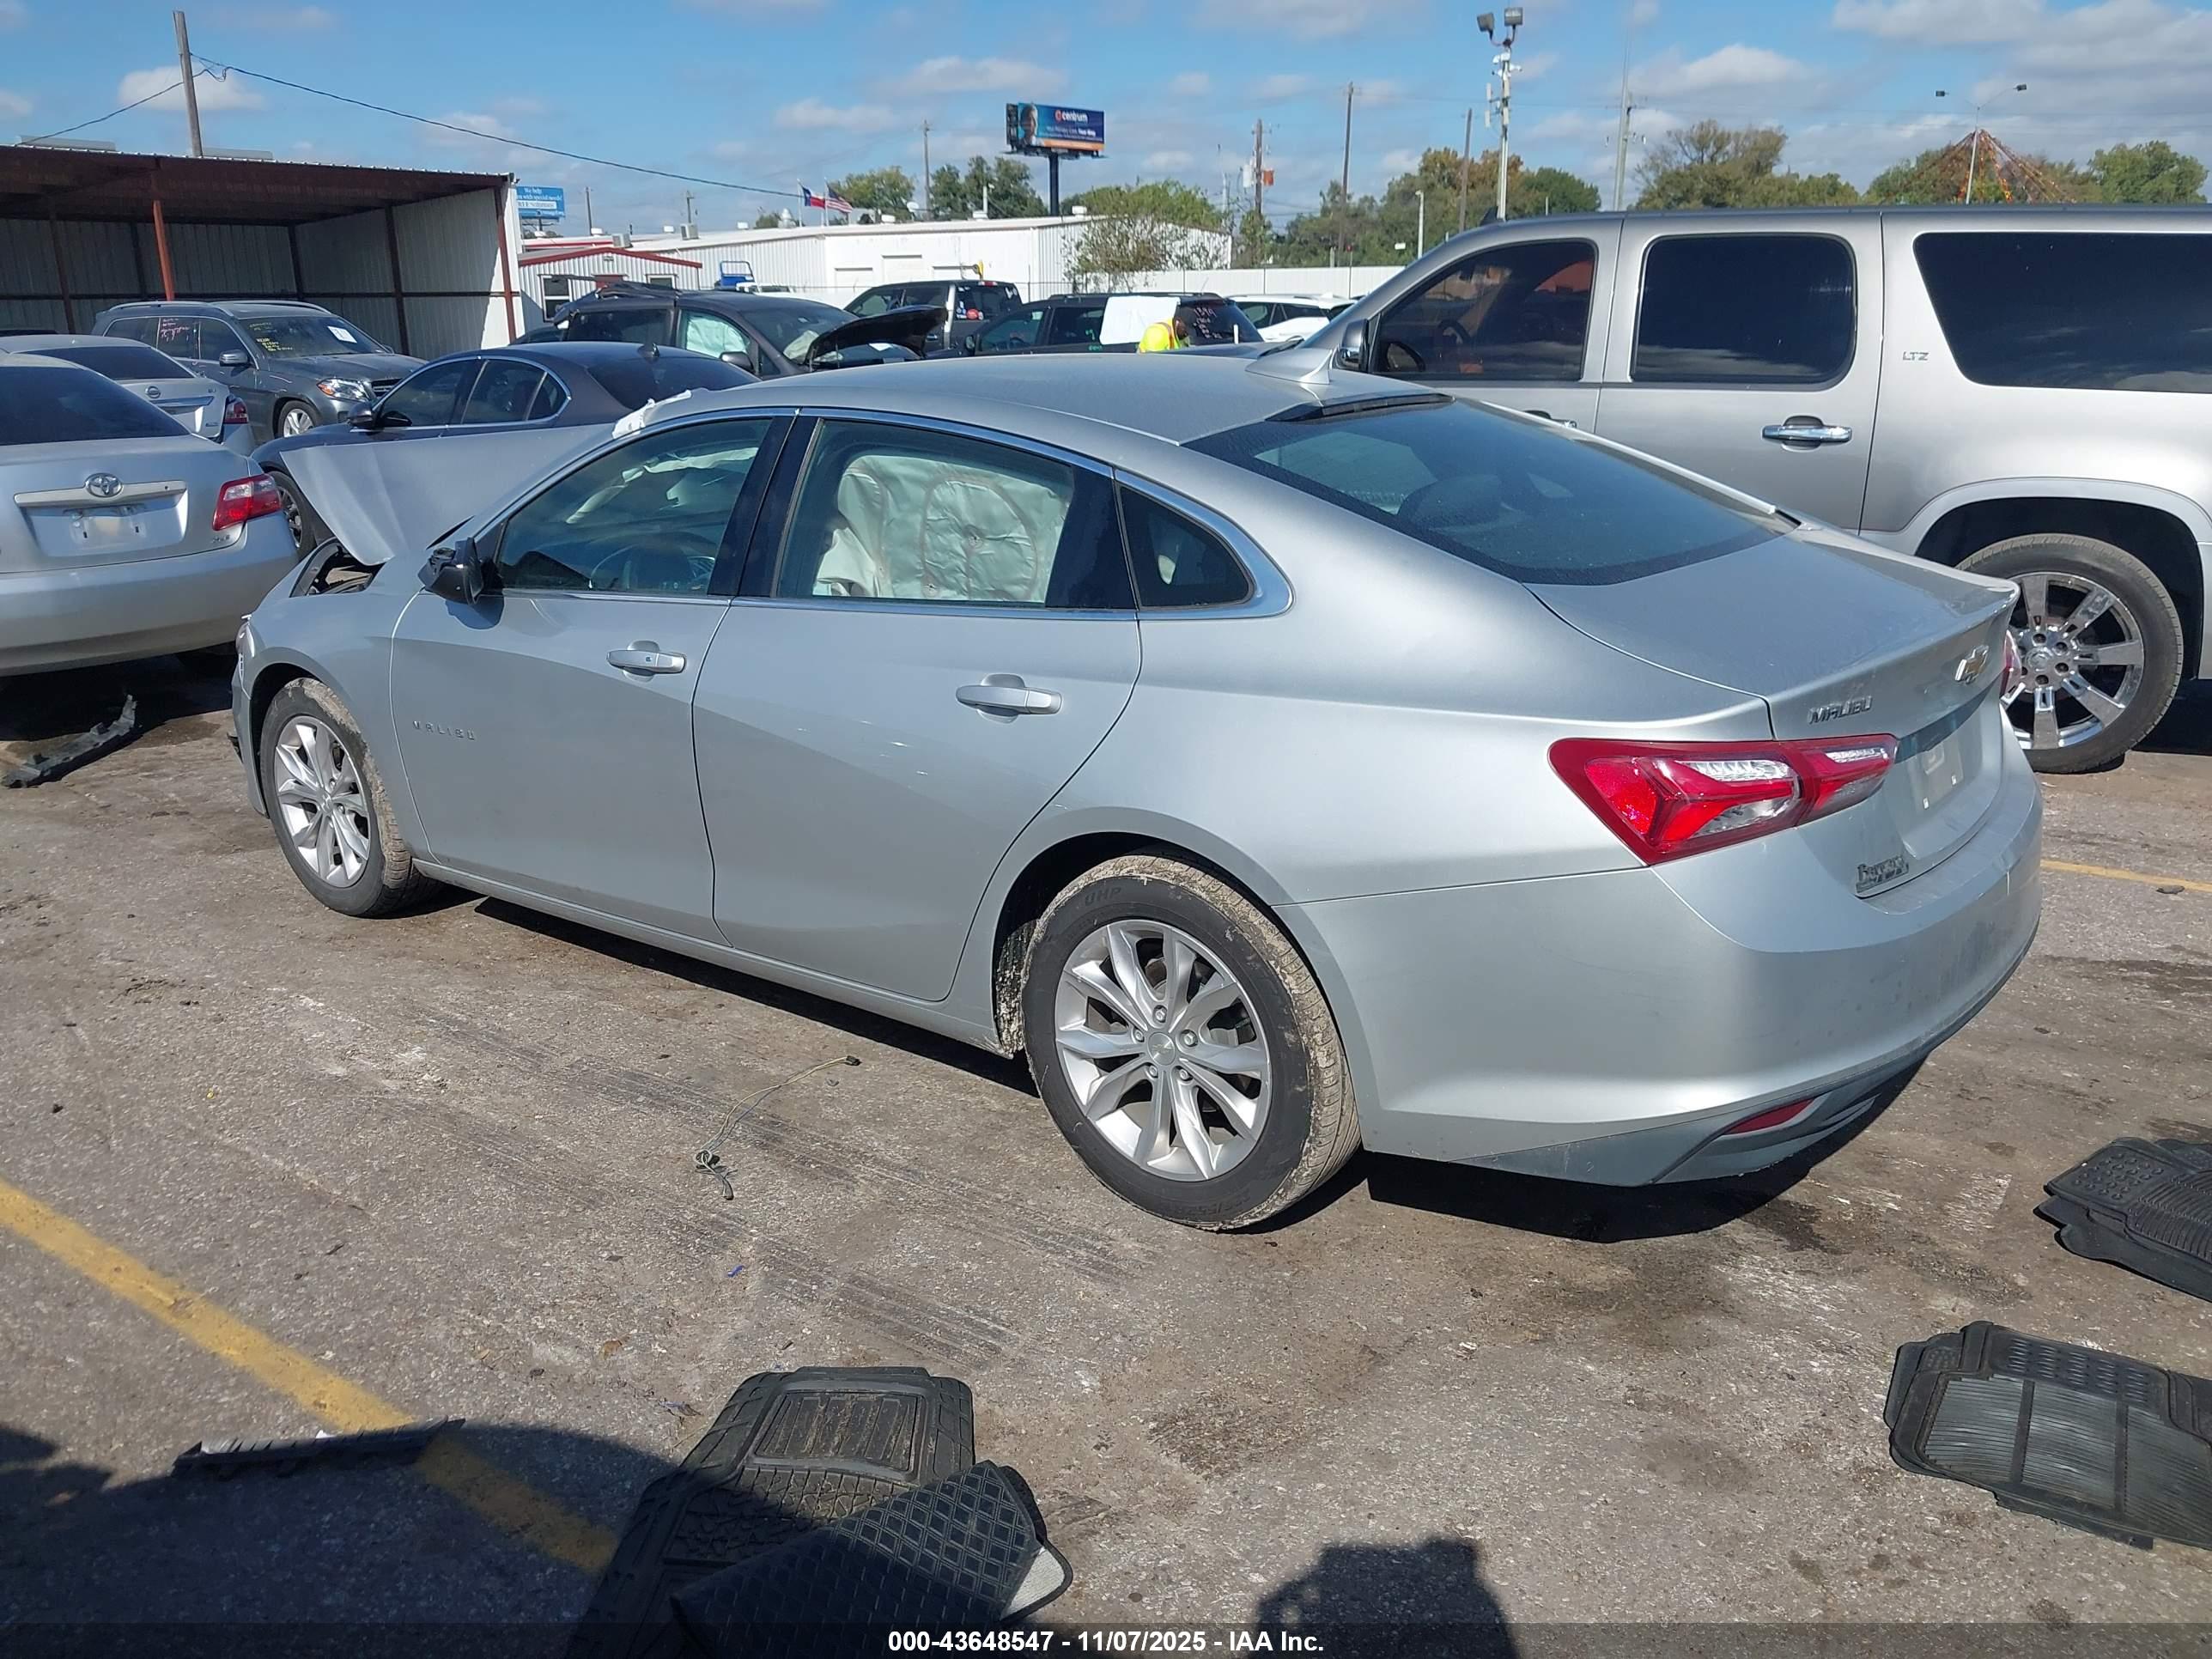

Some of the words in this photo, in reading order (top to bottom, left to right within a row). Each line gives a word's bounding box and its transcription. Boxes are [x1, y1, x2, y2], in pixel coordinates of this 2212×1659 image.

[1062, 110, 1088, 124] centrum
[1902, 351, 1929, 361] LTZ
[1807, 696, 1873, 725] MALIBU
[412, 720, 475, 740] MALIBU
